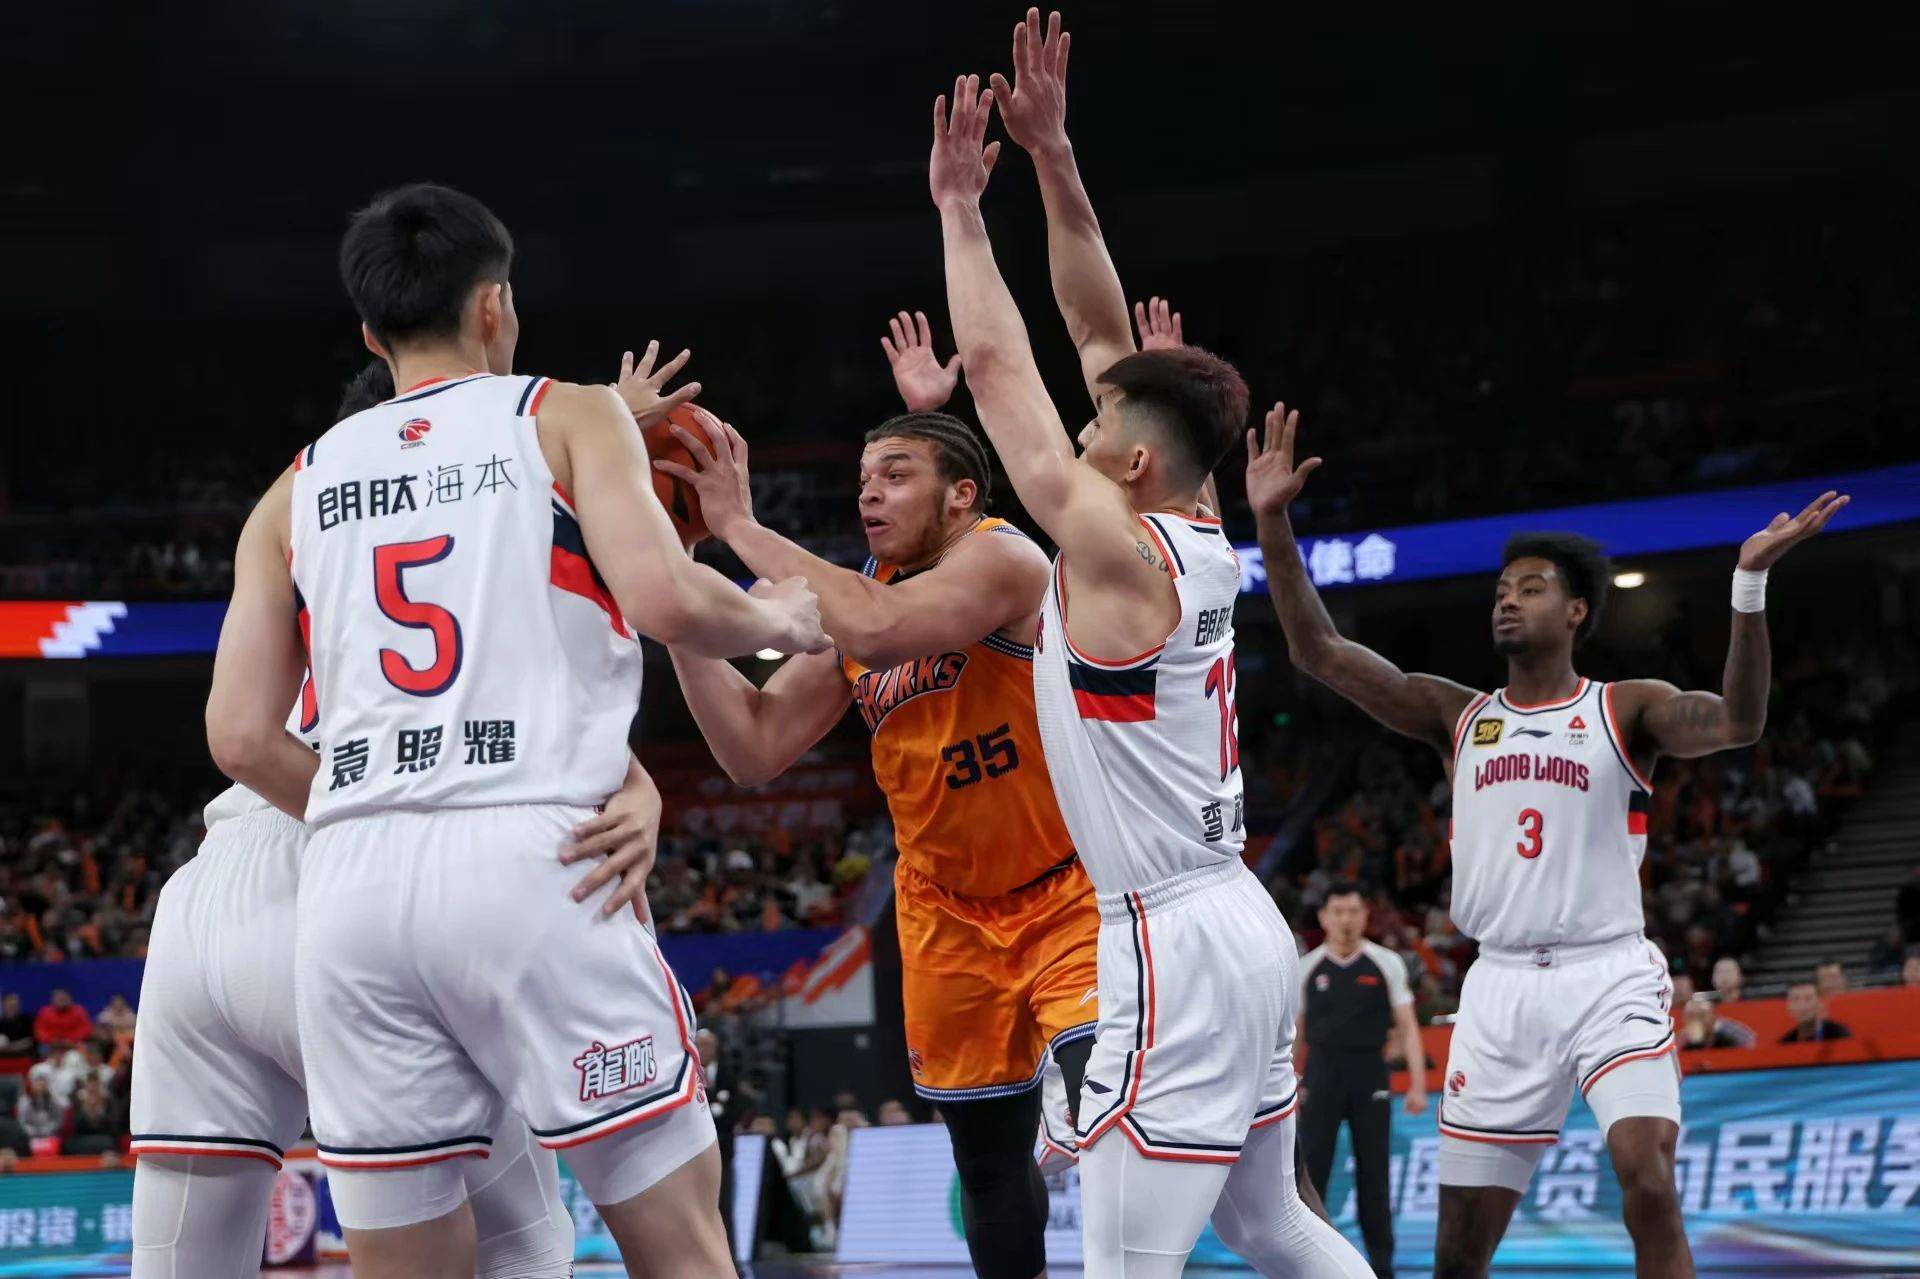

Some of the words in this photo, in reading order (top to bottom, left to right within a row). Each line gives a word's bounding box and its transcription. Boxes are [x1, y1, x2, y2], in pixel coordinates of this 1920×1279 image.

[318, 453, 519, 531] 朗肽海本
[1240, 533, 1397, 592] 不使命
[373, 534, 463, 697] 5
[852, 652, 969, 735] HARKS
[329, 720, 515, 791] 袁照耀
[941, 722, 1019, 790] 35
[1534, 753, 1589, 792] LIONS
[1516, 808, 1543, 859] 3
